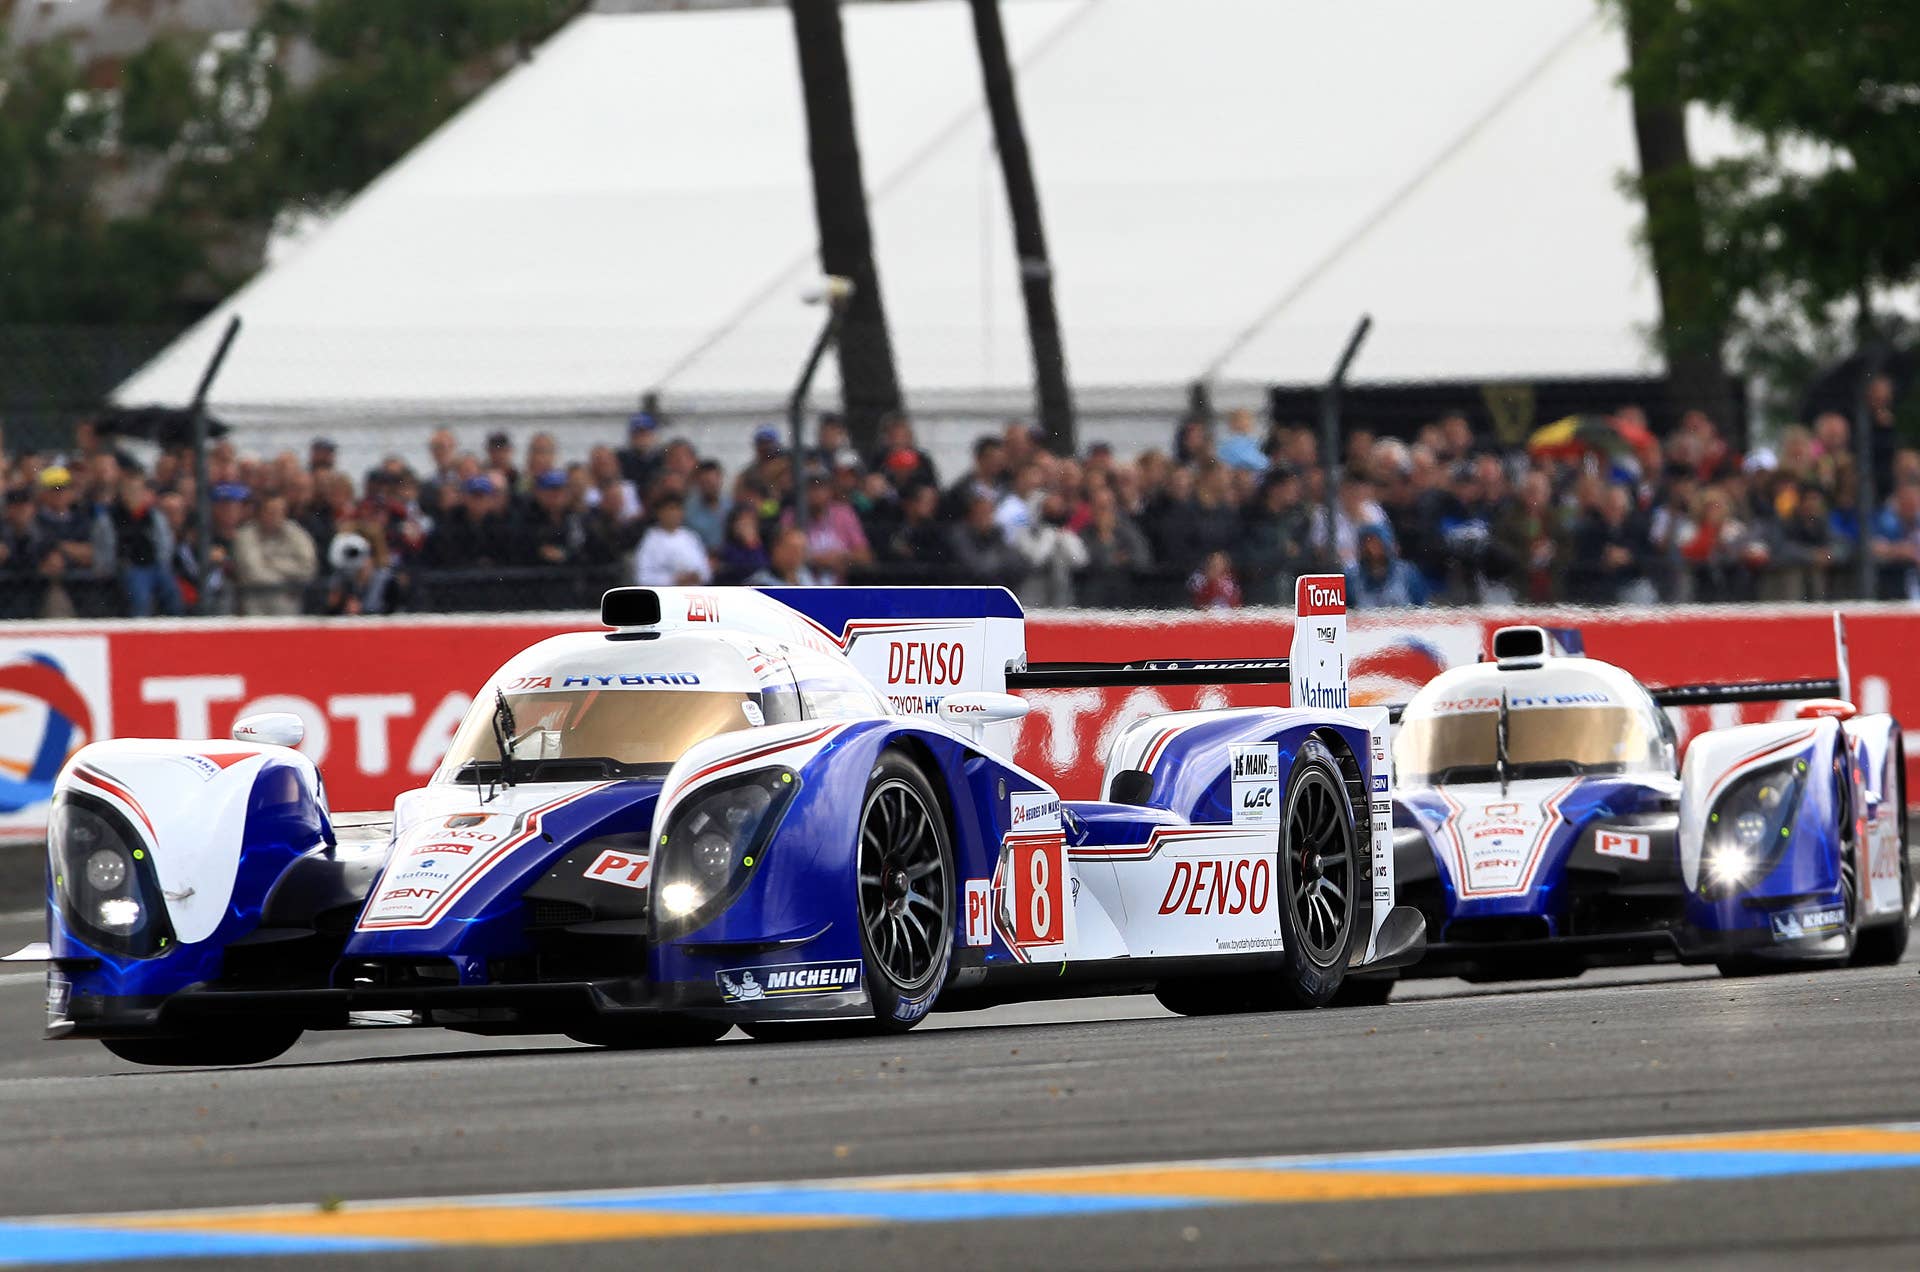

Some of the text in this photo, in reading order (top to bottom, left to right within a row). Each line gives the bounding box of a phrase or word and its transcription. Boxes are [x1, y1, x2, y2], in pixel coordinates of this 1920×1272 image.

[1307, 584, 1345, 607] TOTAL
[683, 593, 720, 622] ZENT
[888, 642, 964, 686] DENSO
[563, 672, 701, 687] HYBRID
[1300, 677, 1347, 709] Matmut
[948, 704, 987, 713] TOTAL
[141, 675, 475, 774] TOTA
[1245, 753, 1268, 775] MANS
[1243, 787, 1274, 808] WEC
[1013, 805, 1025, 825] 24
[1602, 834, 1639, 855] P1
[593, 855, 649, 882] P1
[380, 888, 440, 901] ZENT
[1030, 848, 1051, 938] 8
[1158, 858, 1270, 915] DENSO
[968, 890, 988, 937] P1
[767, 967, 857, 989] MICHELIN
